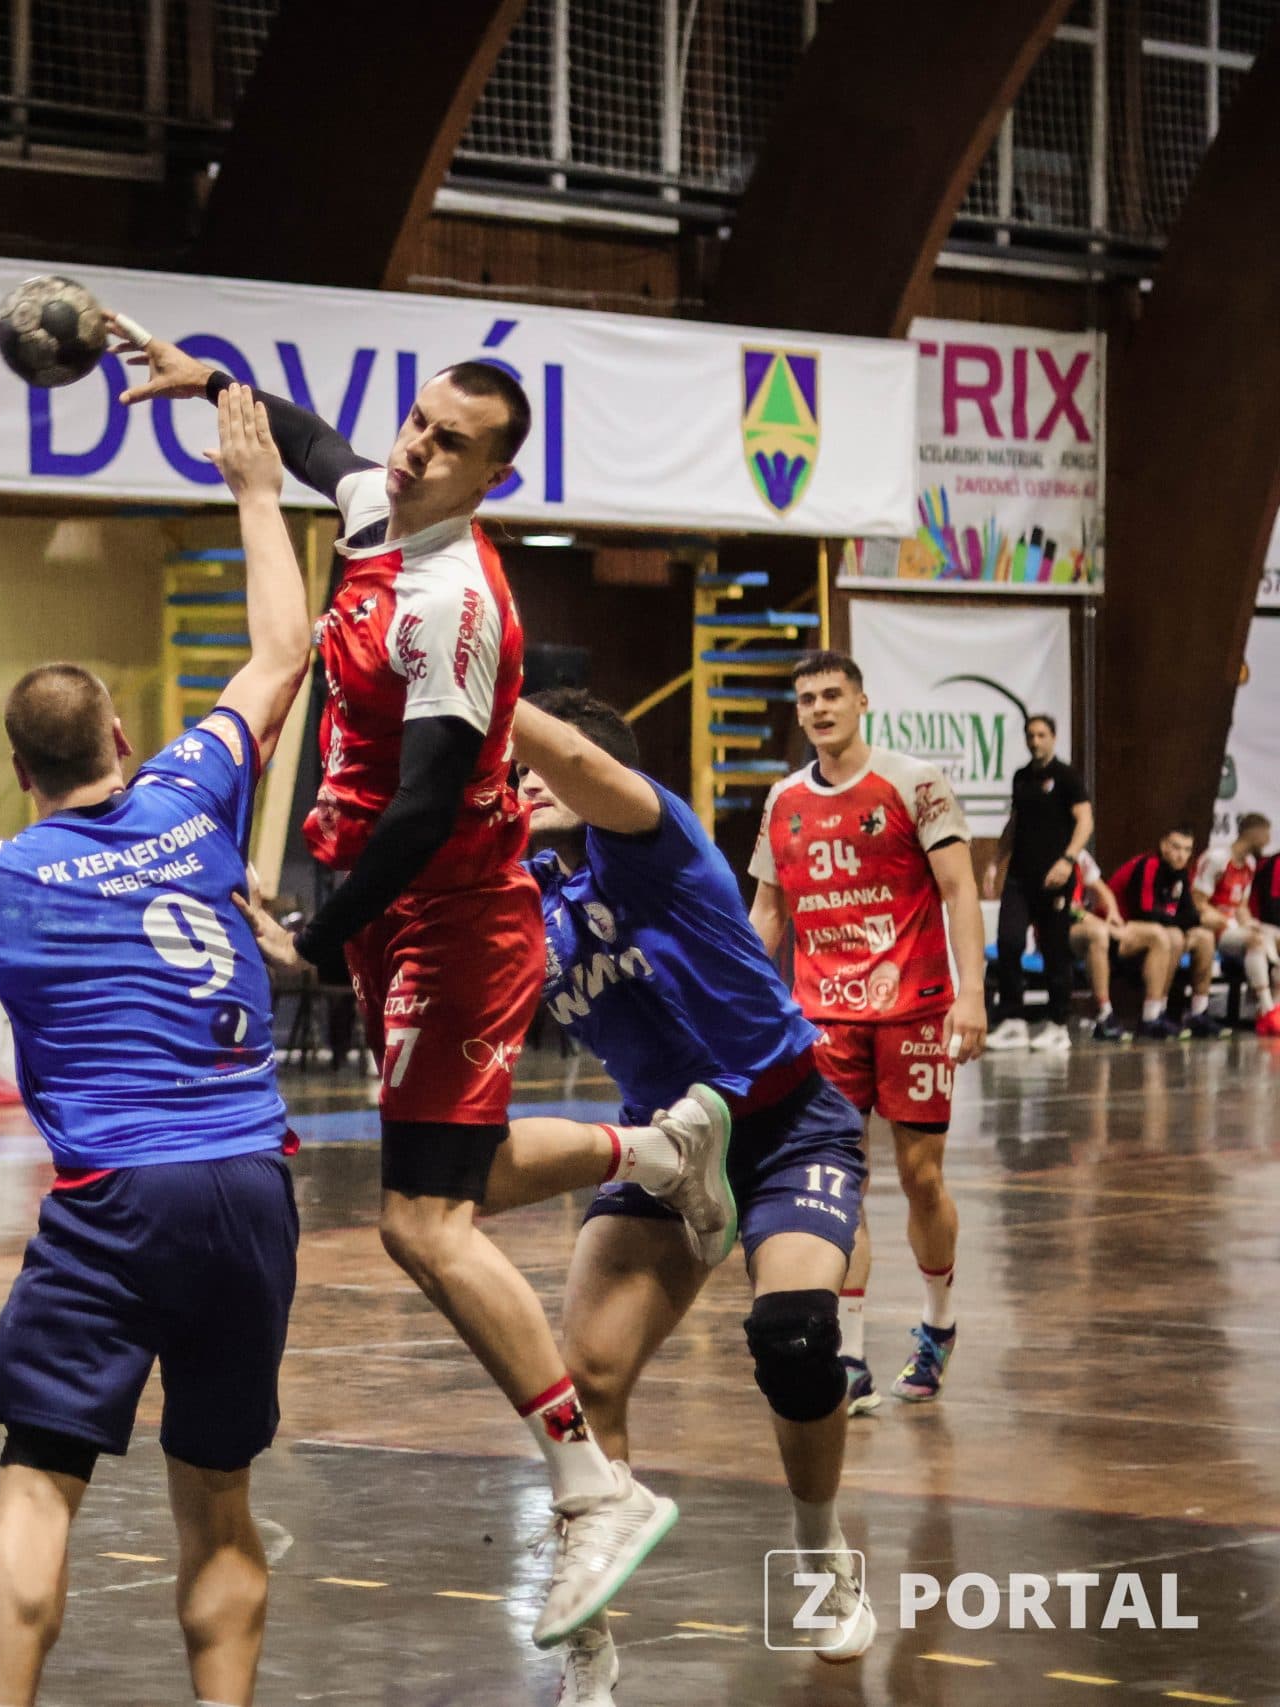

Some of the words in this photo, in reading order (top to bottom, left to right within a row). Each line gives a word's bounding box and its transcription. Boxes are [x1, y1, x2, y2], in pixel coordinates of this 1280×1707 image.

[37, 864, 72, 885] РК
[97, 853, 203, 898] НЕВЕСИЊЕ
[808, 839, 861, 881] 34
[829, 886, 894, 908] BANKA
[142, 893, 236, 999] 9
[908, 1063, 952, 1101] 34
[805, 1164, 846, 1199] 17
[795, 1198, 848, 1224] KELME
